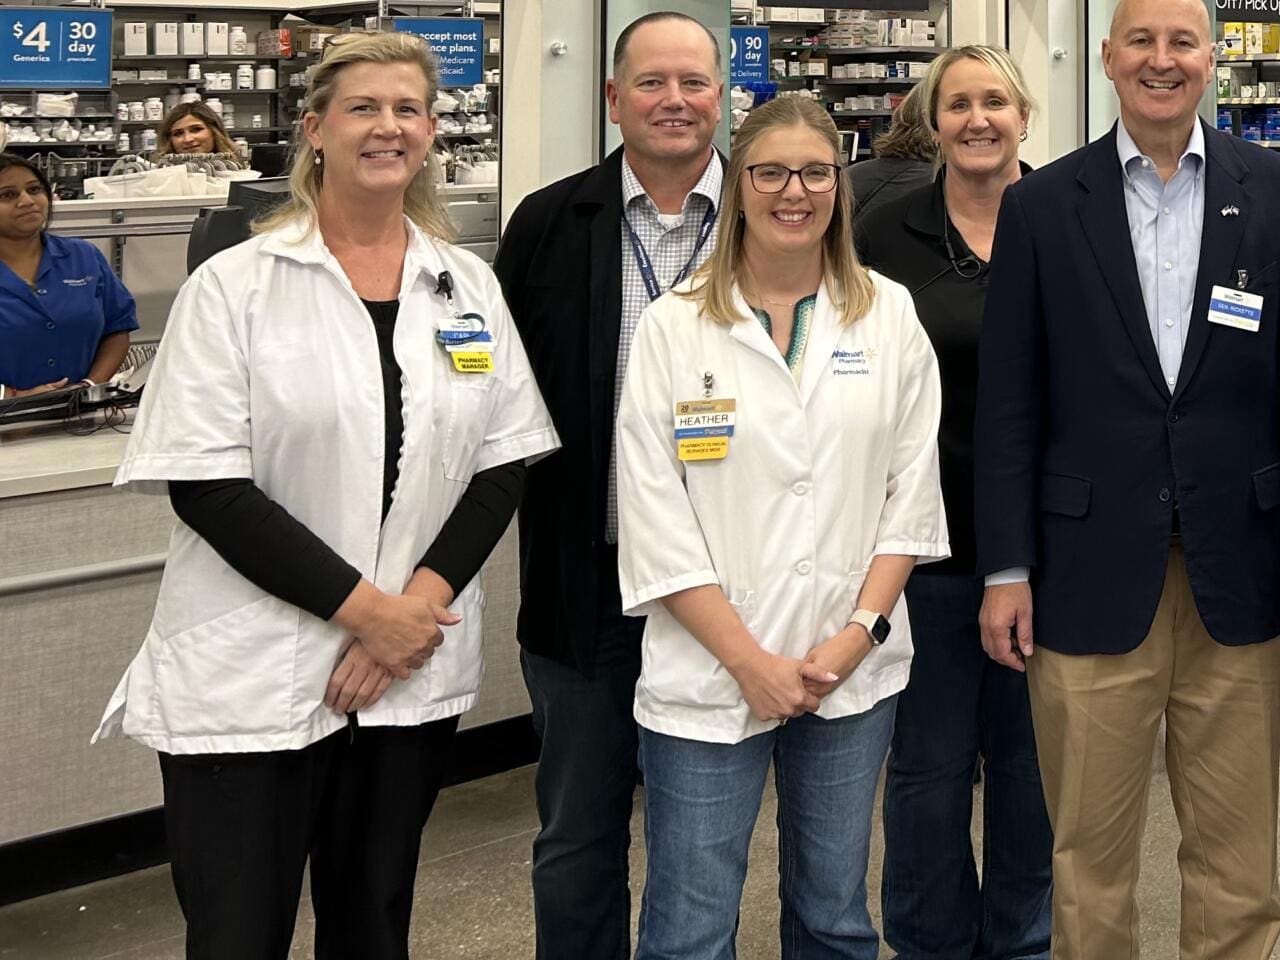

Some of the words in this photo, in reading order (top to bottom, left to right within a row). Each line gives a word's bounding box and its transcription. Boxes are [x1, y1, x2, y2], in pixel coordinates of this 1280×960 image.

[13, 21, 50, 52] $4
[68, 22, 96, 40] 30
[453, 33, 477, 41] most
[68, 40, 96, 56] day
[449, 43, 477, 54] plans.
[745, 36, 762, 50] 90
[13, 54, 51, 62] Generics
[440, 55, 475, 64] Medicare
[745, 50, 762, 62] day
[831, 349, 864, 358] Walmart
[679, 414, 729, 427] HEATHER
